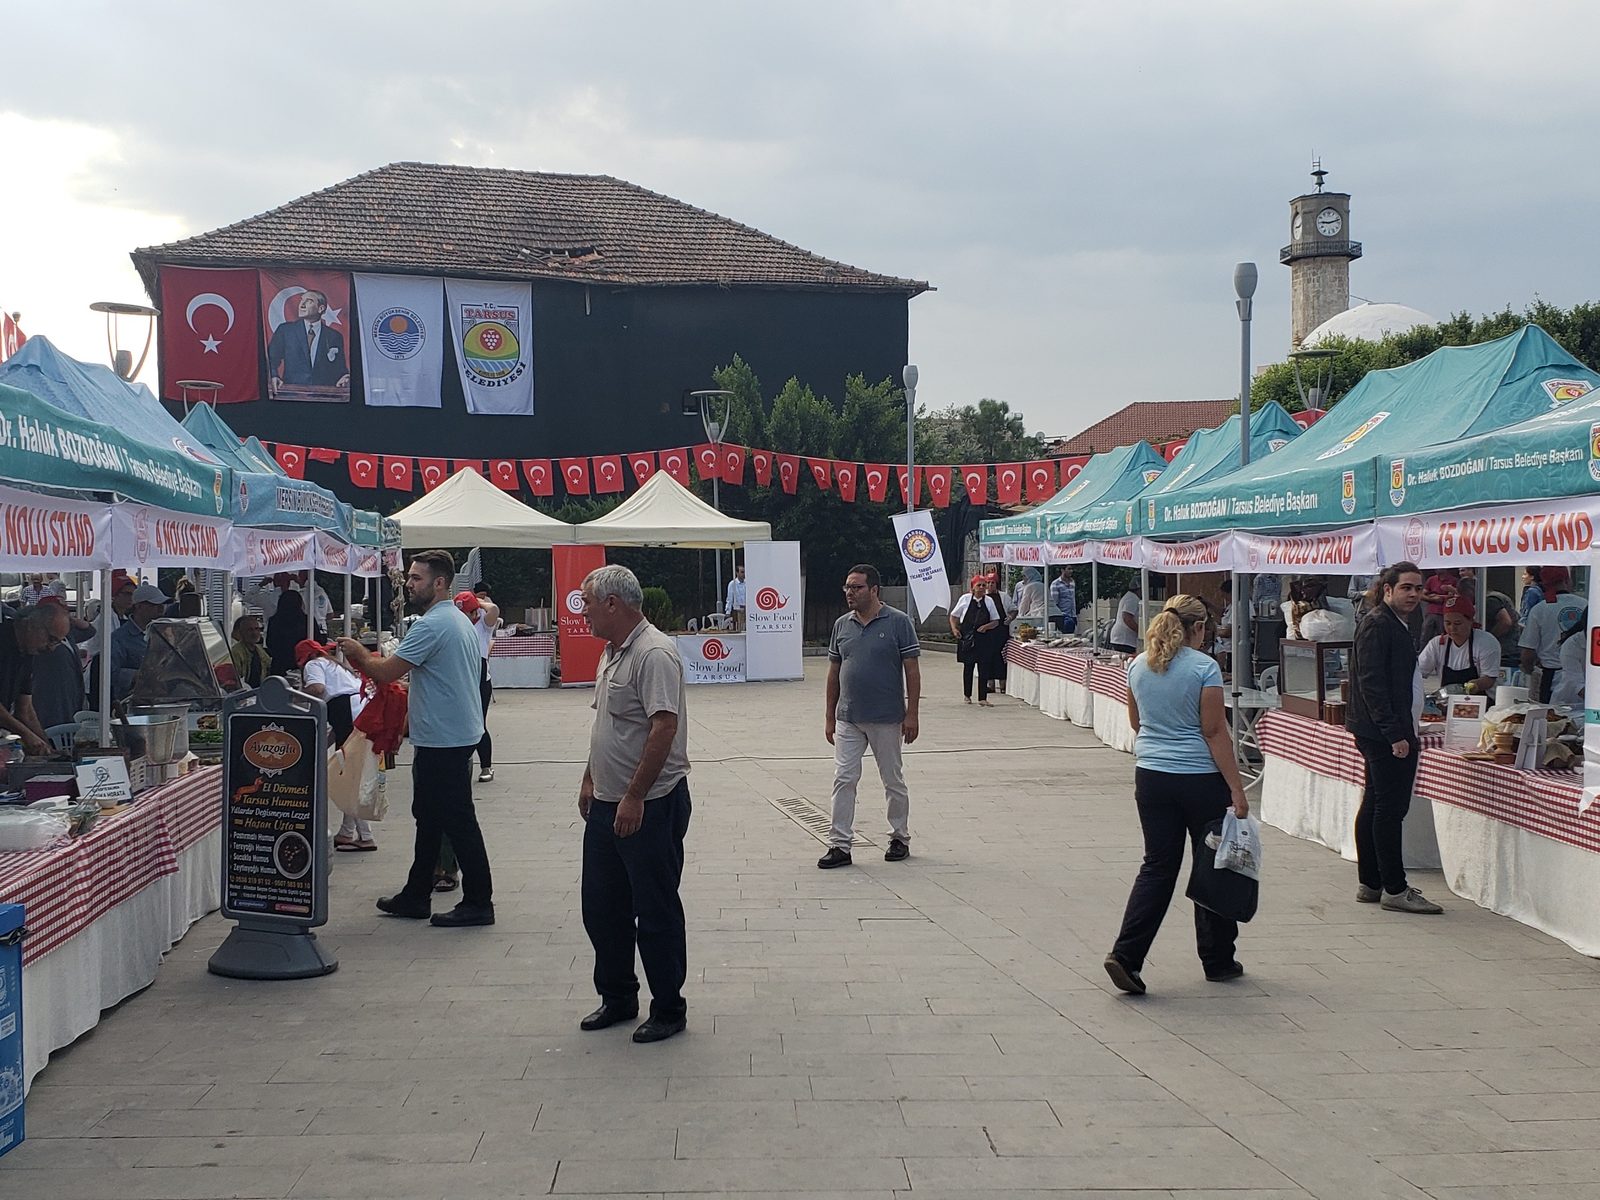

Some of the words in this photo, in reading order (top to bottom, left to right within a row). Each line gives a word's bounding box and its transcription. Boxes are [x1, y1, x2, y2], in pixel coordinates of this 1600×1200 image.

[464, 308, 516, 319] TARSUS
[18, 414, 60, 458] Haluk
[1407, 473, 1417, 486] Dr.
[1418, 468, 1439, 484] Haluk
[1440, 458, 1485, 480] BOZDOĞAN
[1489, 456, 1514, 470] Tarsus
[1514, 451, 1547, 469] Belediye
[1549, 447, 1584, 467] Başkanı
[1164, 506, 1173, 522] Dr.
[1190, 496, 1227, 519] BOZDOĞAN
[1231, 497, 1254, 515] Tarsus
[1253, 493, 1284, 516] Belediye
[1286, 490, 1318, 514] Başkanı
[5, 504, 48, 557] NOLU
[49, 510, 95, 557] STAND
[1438, 522, 1457, 556] 15
[1458, 517, 1515, 555] NOLU
[1517, 512, 1593, 553] STAND
[156, 519, 163, 555] 4
[162, 520, 190, 556] NOLU
[190, 523, 219, 558] STAND
[1266, 539, 1280, 565] 14
[1279, 538, 1313, 565] NOLU
[1311, 535, 1353, 565] STAND
[561, 616, 580, 625] Slow
[750, 613, 770, 622] Slow
[689, 662, 713, 671] Slow
[263, 782, 271, 792] El
[273, 783, 309, 795] Dövmesi
[243, 794, 269, 805] Tarsus
[271, 796, 309, 808] Humusu
[291, 811, 310, 820] Lezzet
[244, 818, 271, 829] Hasan
[274, 819, 294, 830] Usta
[255, 844, 272, 852] Humus
[252, 855, 269, 863] Humus
